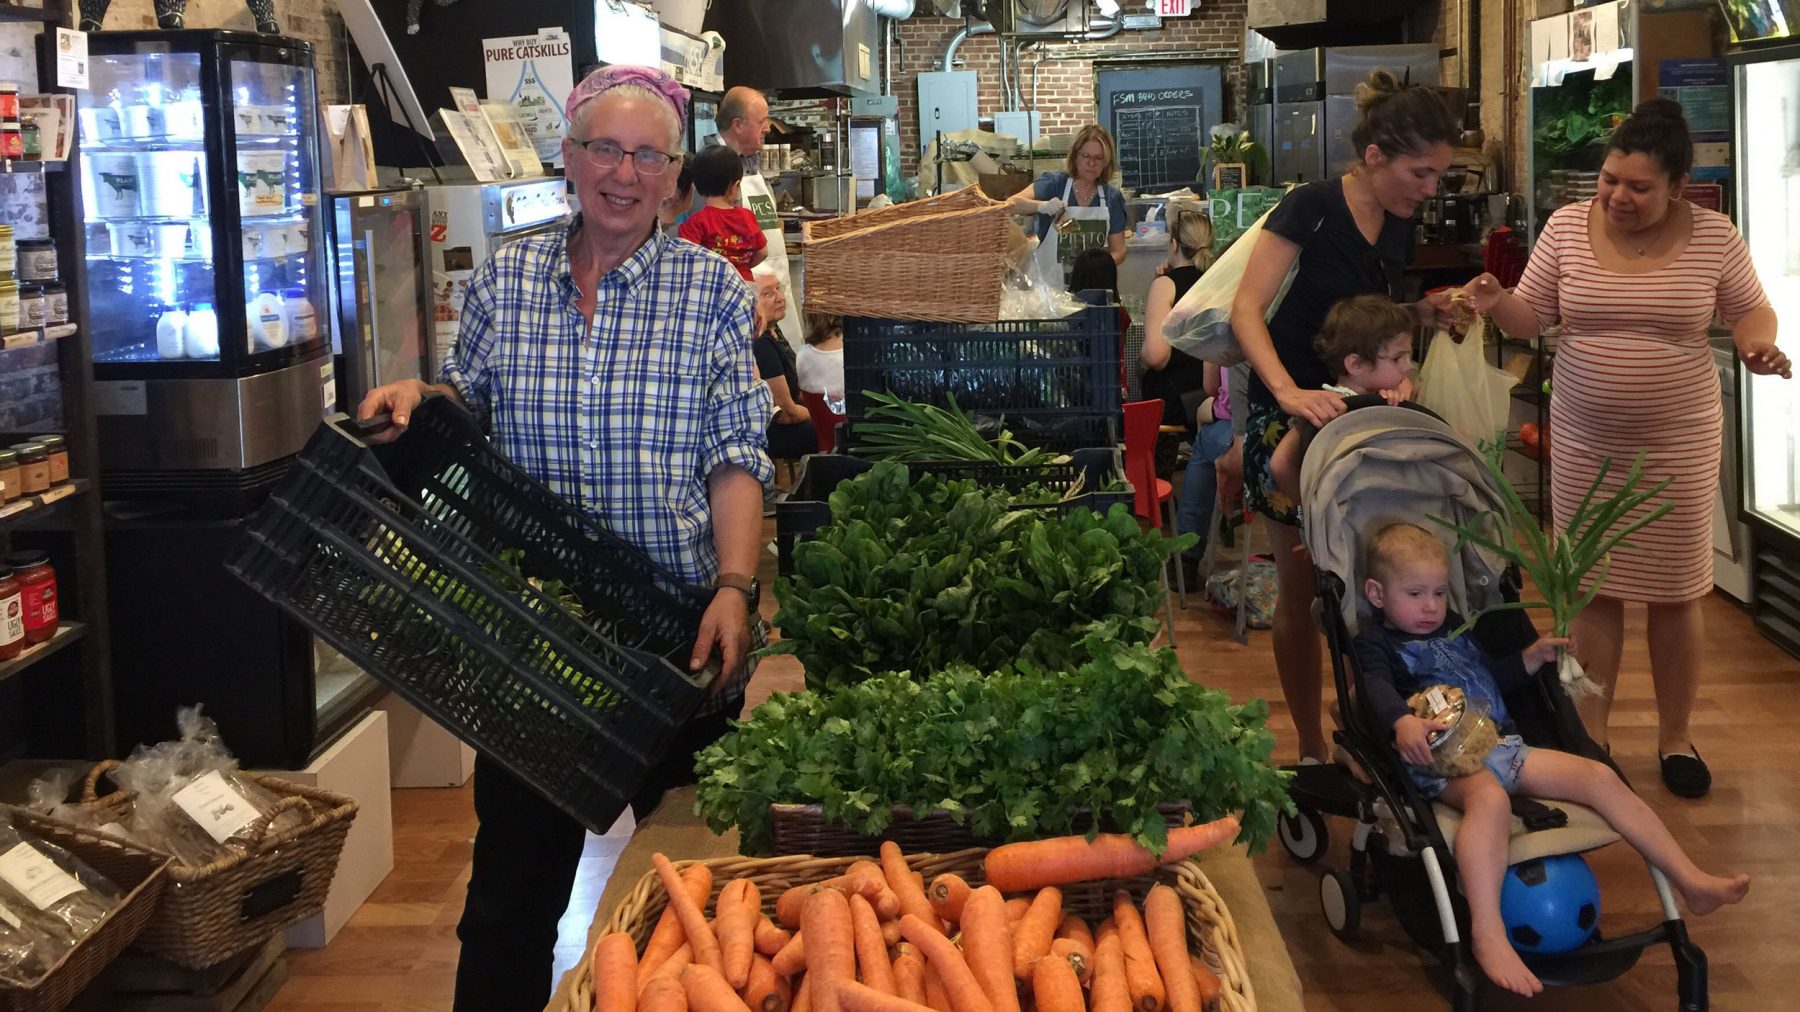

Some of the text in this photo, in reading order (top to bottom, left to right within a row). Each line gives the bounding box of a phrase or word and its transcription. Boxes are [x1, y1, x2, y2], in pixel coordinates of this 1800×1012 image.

[512, 38, 538, 47] WHY BUY
[485, 42, 570, 62] PURE CATSKILLS
